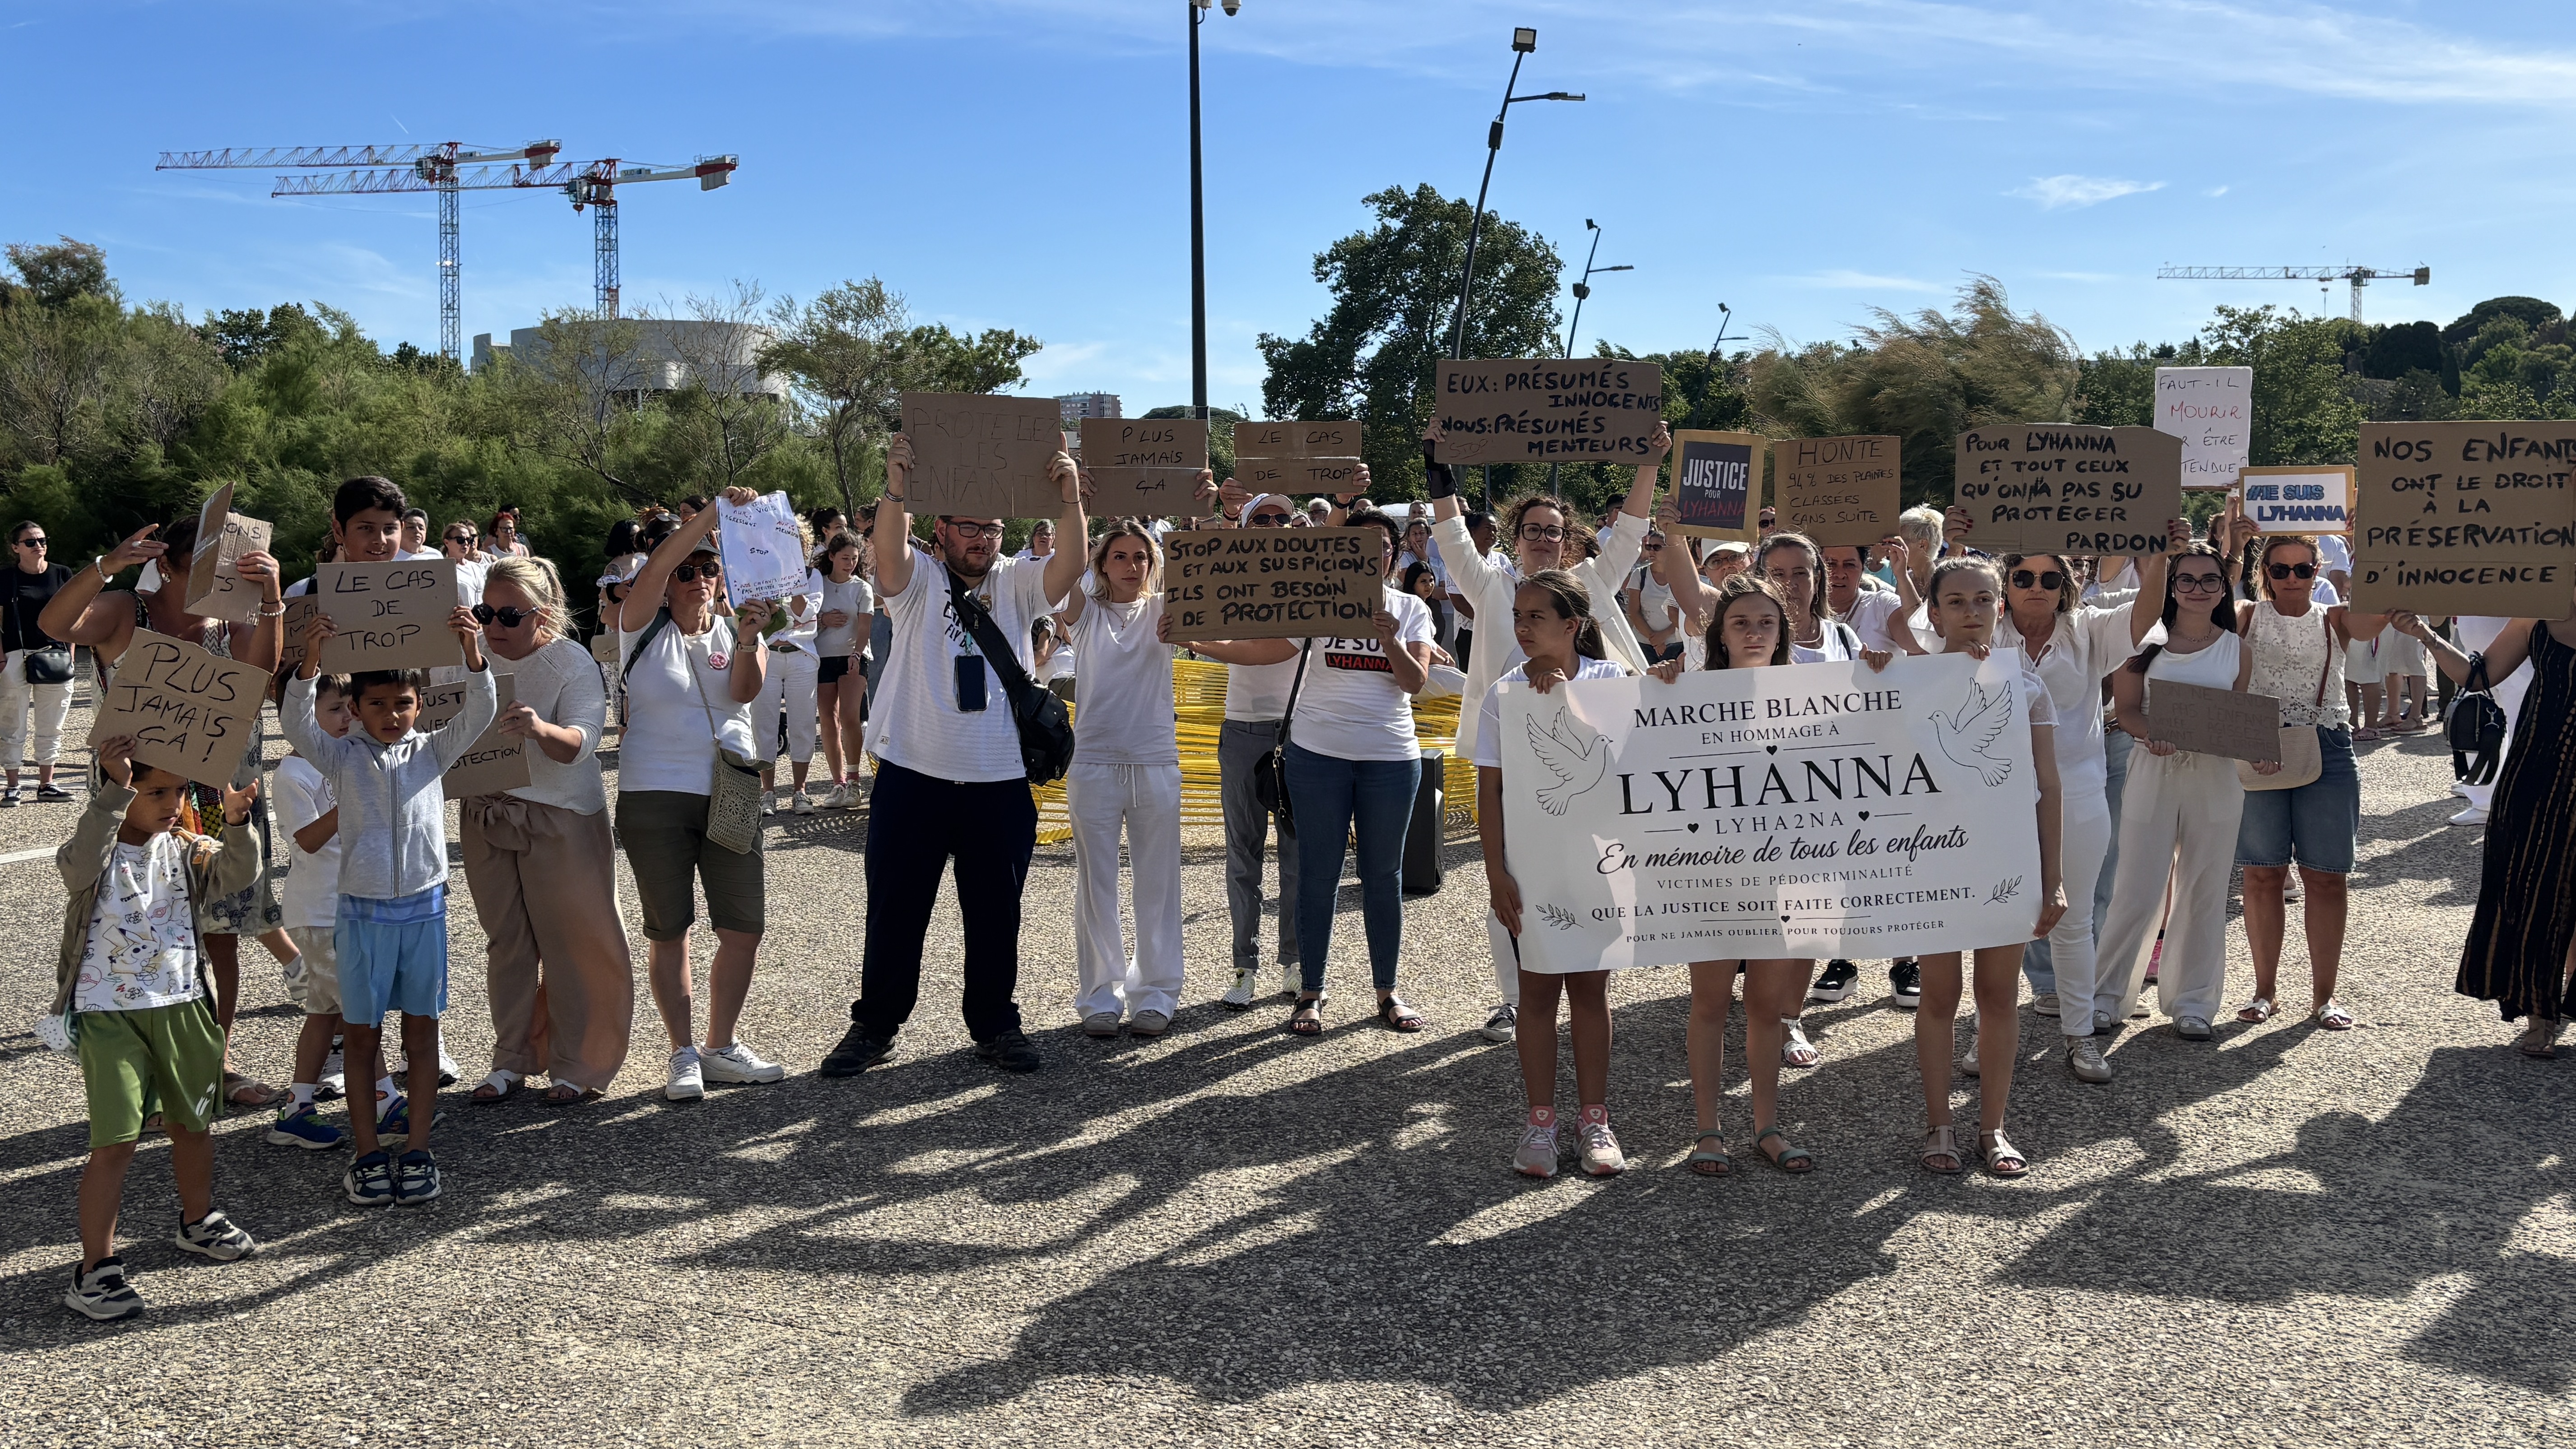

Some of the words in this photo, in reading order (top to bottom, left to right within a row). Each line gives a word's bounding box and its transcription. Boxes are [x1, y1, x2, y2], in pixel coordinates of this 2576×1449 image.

[1505, 363, 1629, 391] PRÉSUMÉS
[1494, 410, 1605, 434] PRÉSUMÉS
[2171, 401, 2241, 422] MOURIR
[1123, 427, 1174, 443] PLUS
[1258, 430, 1281, 443] LE
[1306, 431, 1343, 444] CAS
[1966, 433, 2009, 453] POUR
[2026, 431, 2116, 454] LYHANNA
[2203, 427, 2238, 446] ÊTRE
[960, 442, 1007, 470] LES
[1114, 450, 1183, 465] JAMAIS
[1528, 437, 1650, 457] MENTEURS
[1798, 439, 1883, 465] HONTE
[2375, 437, 2433, 462] NOS
[1255, 469, 1281, 481] DE
[1307, 468, 1352, 481] TROP
[1683, 459, 1748, 490] JUSTICE
[1827, 474, 1847, 483] DES
[1853, 469, 1894, 483] PLAINTES
[1980, 460, 2003, 474] ET
[2010, 458, 2067, 474] TOUT
[2075, 460, 2129, 474] CEUX
[2392, 474, 2442, 492] ONT
[2457, 475, 2481, 490] LE
[2495, 465, 2570, 489] DROIT
[1705, 489, 1721, 499] POUR
[1790, 490, 1859, 507] CLASSÉES
[2062, 481, 2101, 497] PAS
[2111, 481, 2143, 502] SU
[2283, 485, 2325, 500] SUIS
[2423, 492, 2437, 514] À
[2458, 498, 2491, 513] LA
[1792, 513, 1826, 525] SANS
[1835, 509, 1879, 523] SUITE
[1992, 497, 2127, 523] PROTÉGER
[2258, 506, 2347, 521] LYHANNA
[2066, 532, 2167, 553] PARDON
[2367, 520, 2576, 548] PRÉSERVATION
[1170, 538, 1222, 561] STOP
[1226, 539, 1267, 554] AUX
[1274, 537, 1362, 554] DOUTES
[1183, 563, 1204, 577] ET
[1209, 560, 1248, 576] AUX
[1260, 552, 1379, 576] SUSPICIONS
[335, 571, 370, 593] LE
[386, 571, 435, 590] CAS
[1167, 585, 1204, 604] ILS
[1217, 584, 1261, 600] ONT
[1271, 576, 1347, 598] BESOIN
[371, 600, 403, 617] DE
[1183, 611, 1206, 627] DE
[1221, 596, 1372, 625] PROTECTION
[338, 624, 420, 650] TROP
[944, 623, 962, 641] FLY
[1352, 638, 1386, 652] SU
[143, 642, 240, 701] PLUS
[2191, 687, 2214, 701] NE
[114, 686, 233, 738] JAMAIS
[1633, 700, 1756, 728] MARCHE
[1766, 690, 1902, 720] BLANCHE
[1701, 731, 1724, 745] EN
[1730, 724, 1822, 743] HOMMAGE
[1828, 720, 1841, 736] À
[1616, 752, 1942, 815] LYHANNA
[1597, 843, 1639, 875] En
[1645, 845, 1746, 868] mémoire
[1753, 835, 1782, 862] de
[1790, 836, 1839, 860] tous
[1847, 828, 1879, 856] les
[1886, 824, 1969, 862] enfants
[1657, 878, 1733, 889] VICTIMES
[1741, 876, 1760, 887] DE
[1769, 864, 1913, 886] PÉDOCRIMINALITÉ
[1591, 906, 1626, 921] QUE
[1634, 905, 1654, 917] LA
[1661, 901, 1730, 915] JUSTICE
[1737, 900, 1777, 912] SOIT
[1785, 897, 1833, 910] FAITE
[1840, 887, 1976, 909] CORRECTEMENT.
[1626, 933, 1656, 943] POUR
[1681, 929, 1723, 938] JAMAIS
[1823, 925, 1883, 935] TOUJOURS
[1888, 920, 1944, 933] PROTÉGER
